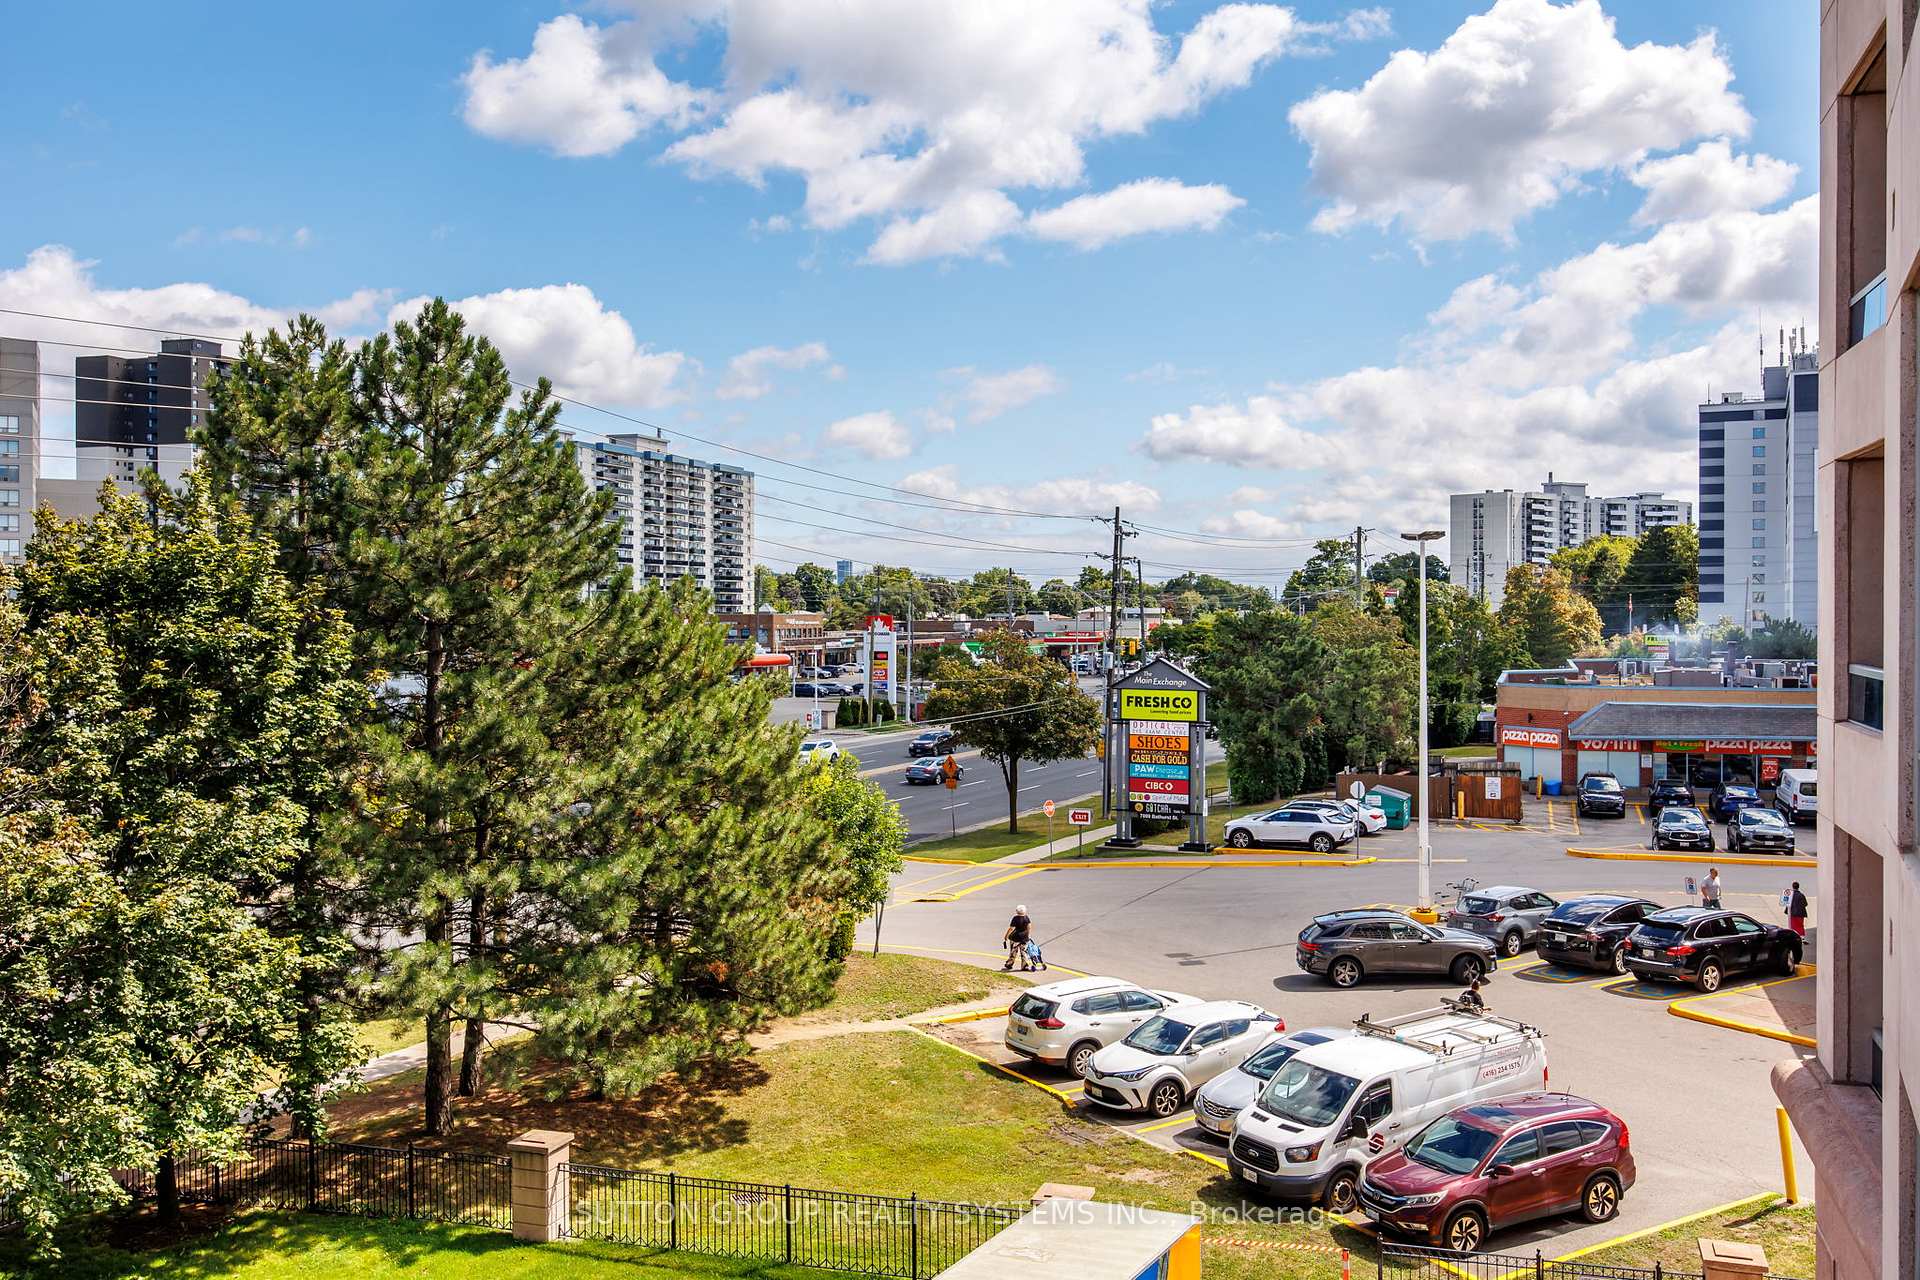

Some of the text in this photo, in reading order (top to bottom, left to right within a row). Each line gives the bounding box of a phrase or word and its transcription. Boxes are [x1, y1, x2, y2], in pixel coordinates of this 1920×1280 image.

[1134, 676, 1187, 688] Main Exchange
[1132, 721, 1171, 730] OPTICAL
[1137, 735, 1182, 749] SHOES
[1502, 730, 1558, 746] pizza pizza
[1705, 739, 1792, 753] pizza pizza
[1131, 754, 1188, 765] CASH FOR GOLD
[1135, 764, 1155, 773] PAW
[1145, 782, 1165, 790] CIBC
